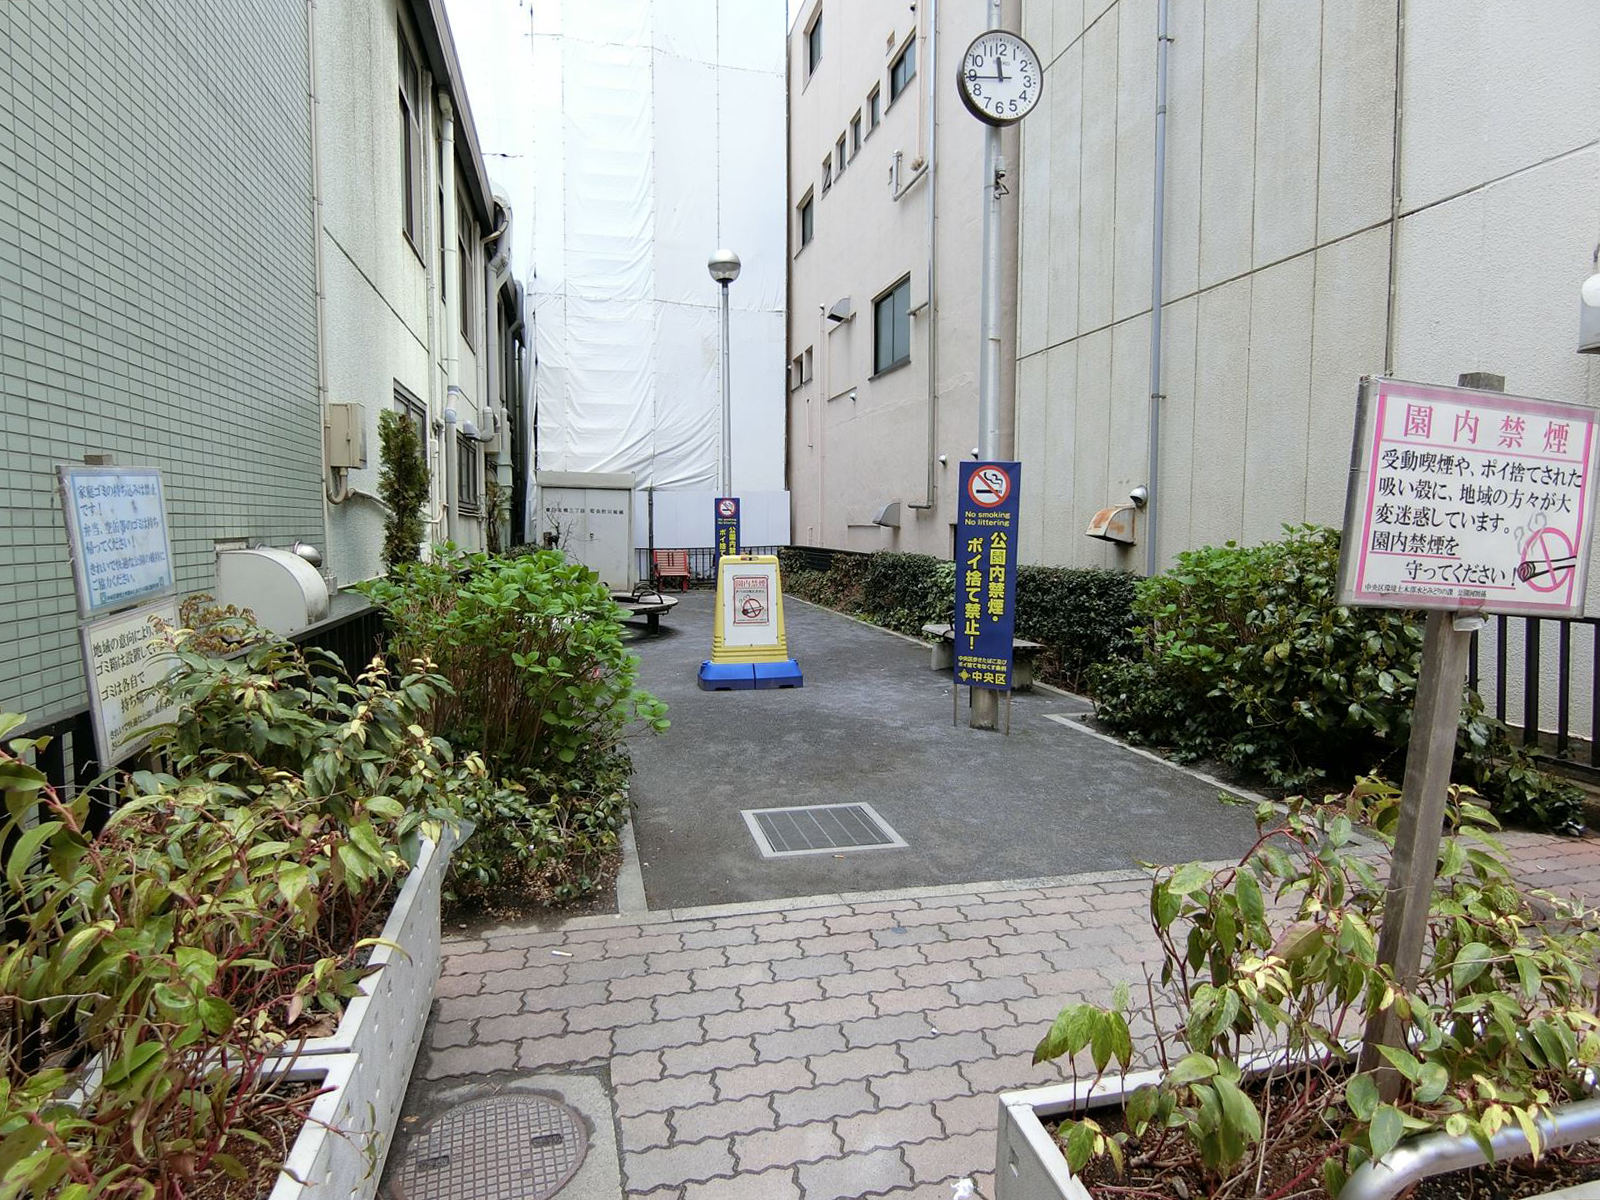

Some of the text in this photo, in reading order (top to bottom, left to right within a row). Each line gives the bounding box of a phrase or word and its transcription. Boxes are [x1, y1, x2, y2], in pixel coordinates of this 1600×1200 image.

[996, 42, 1007, 56] 12
[972, 54, 984, 68] 10
[1020, 60, 1028, 72] 2
[968, 69, 977, 82] 9
[1023, 75, 1032, 88] 3
[973, 83, 982, 96] 8
[1019, 90, 1027, 102] 4
[984, 96, 992, 108] 7
[996, 102, 1004, 114] 6
[1009, 100, 1017, 112] 5
[1403, 402, 1571, 455] 園内禁煙
[1381, 449, 1583, 488] 受動喫煙や、ポイ捨てされた
[1378, 476, 1572, 514] 吸い殻に、地域の方々が大
[964, 510, 1011, 519] No smoking
[1374, 503, 1511, 535] 変迷惑しています。
[964, 518, 1010, 527] No littering
[1371, 530, 1460, 556] 園内禁煙を
[972, 670, 1007, 685] 中央区
